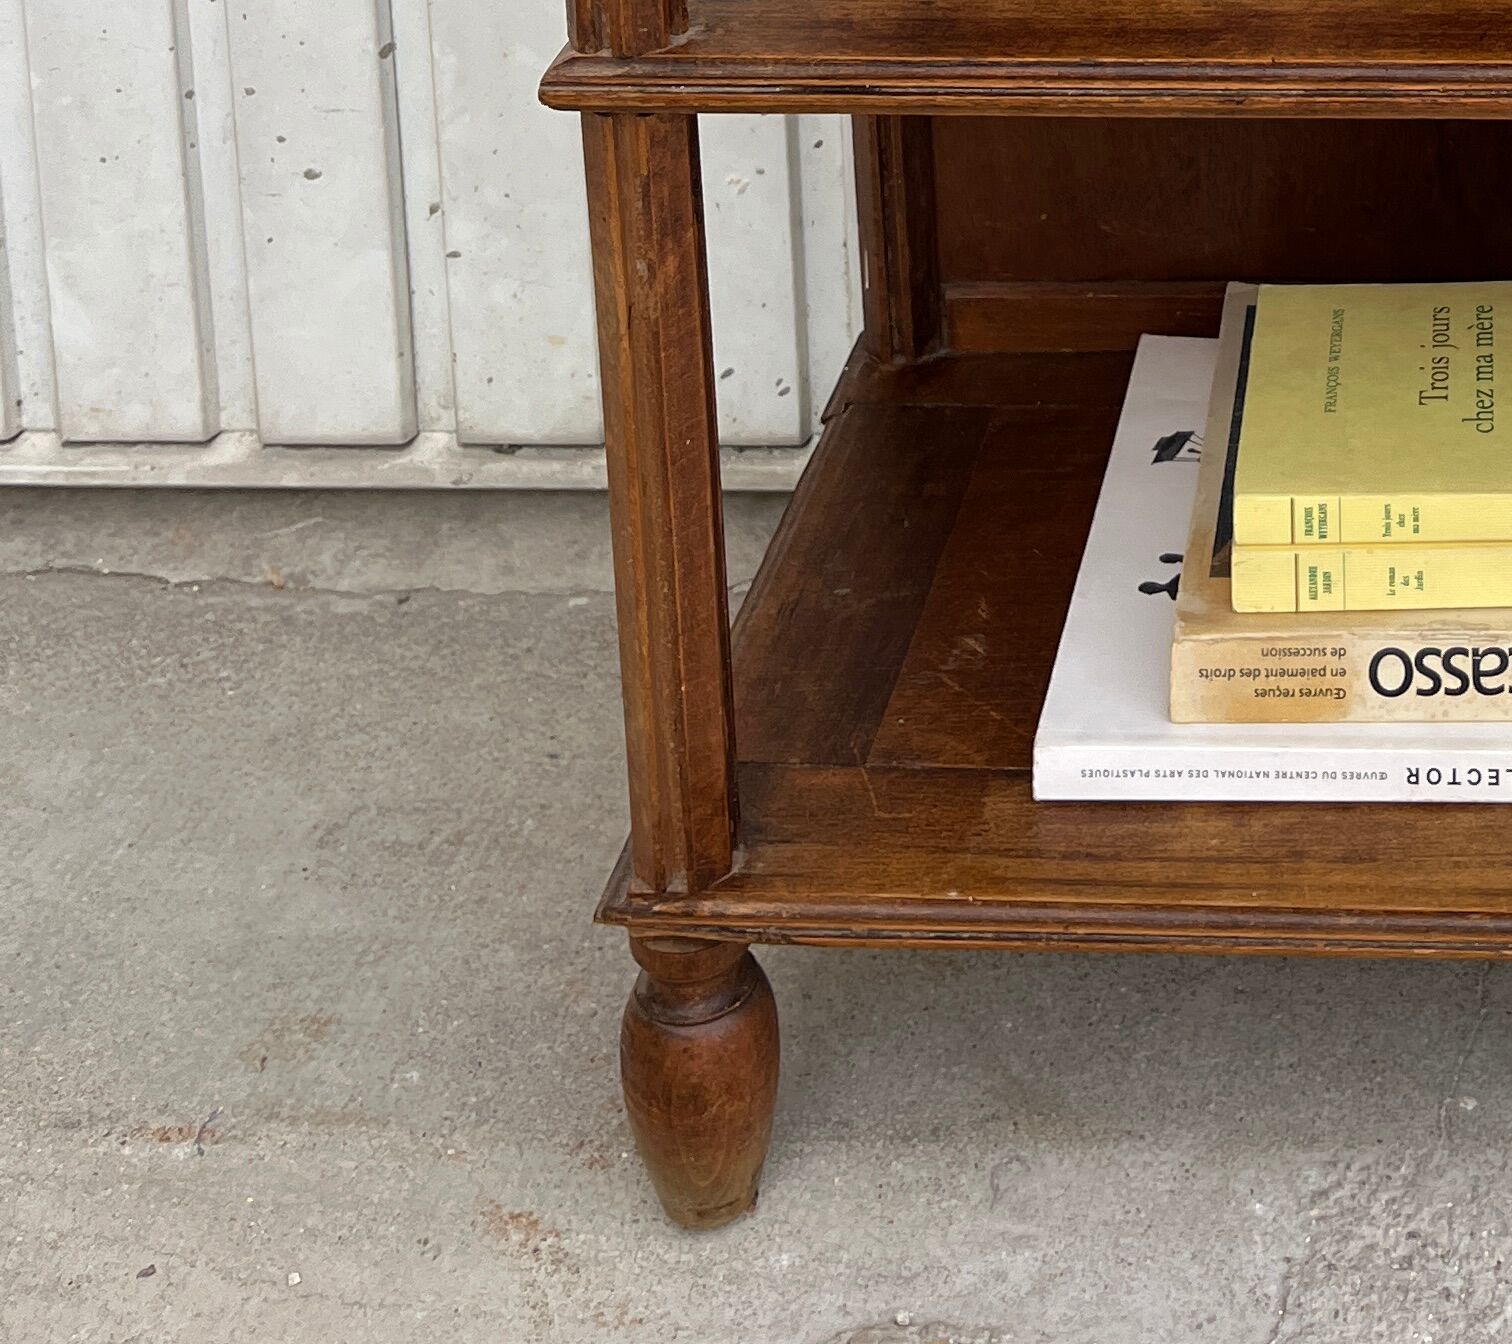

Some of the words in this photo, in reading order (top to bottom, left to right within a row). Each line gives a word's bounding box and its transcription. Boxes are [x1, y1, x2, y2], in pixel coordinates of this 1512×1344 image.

[1420, 306, 1459, 351] jours
[1467, 305, 1494, 347] mère
[1475, 354, 1494, 381] ma
[1418, 356, 1450, 405] Trois
[1462, 388, 1495, 433] chez
[1261, 647, 1327, 659] succession
[1330, 647, 1346, 660] de
[1198, 668, 1236, 680] droits
[1239, 668, 1261, 680] des
[1263, 666, 1327, 680] paiement
[1330, 668, 1347, 677] en
[1254, 684, 1296, 698] reçues
[1298, 687, 1347, 700] Œuvres
[1081, 768, 1150, 779] PLASTIQUES
[1153, 769, 1183, 779] ARTS
[1188, 770, 1209, 779] DES
[1213, 770, 1270, 780] NATIONAL
[1273, 770, 1318, 780] CENTRE
[1322, 771, 1337, 780] DU
